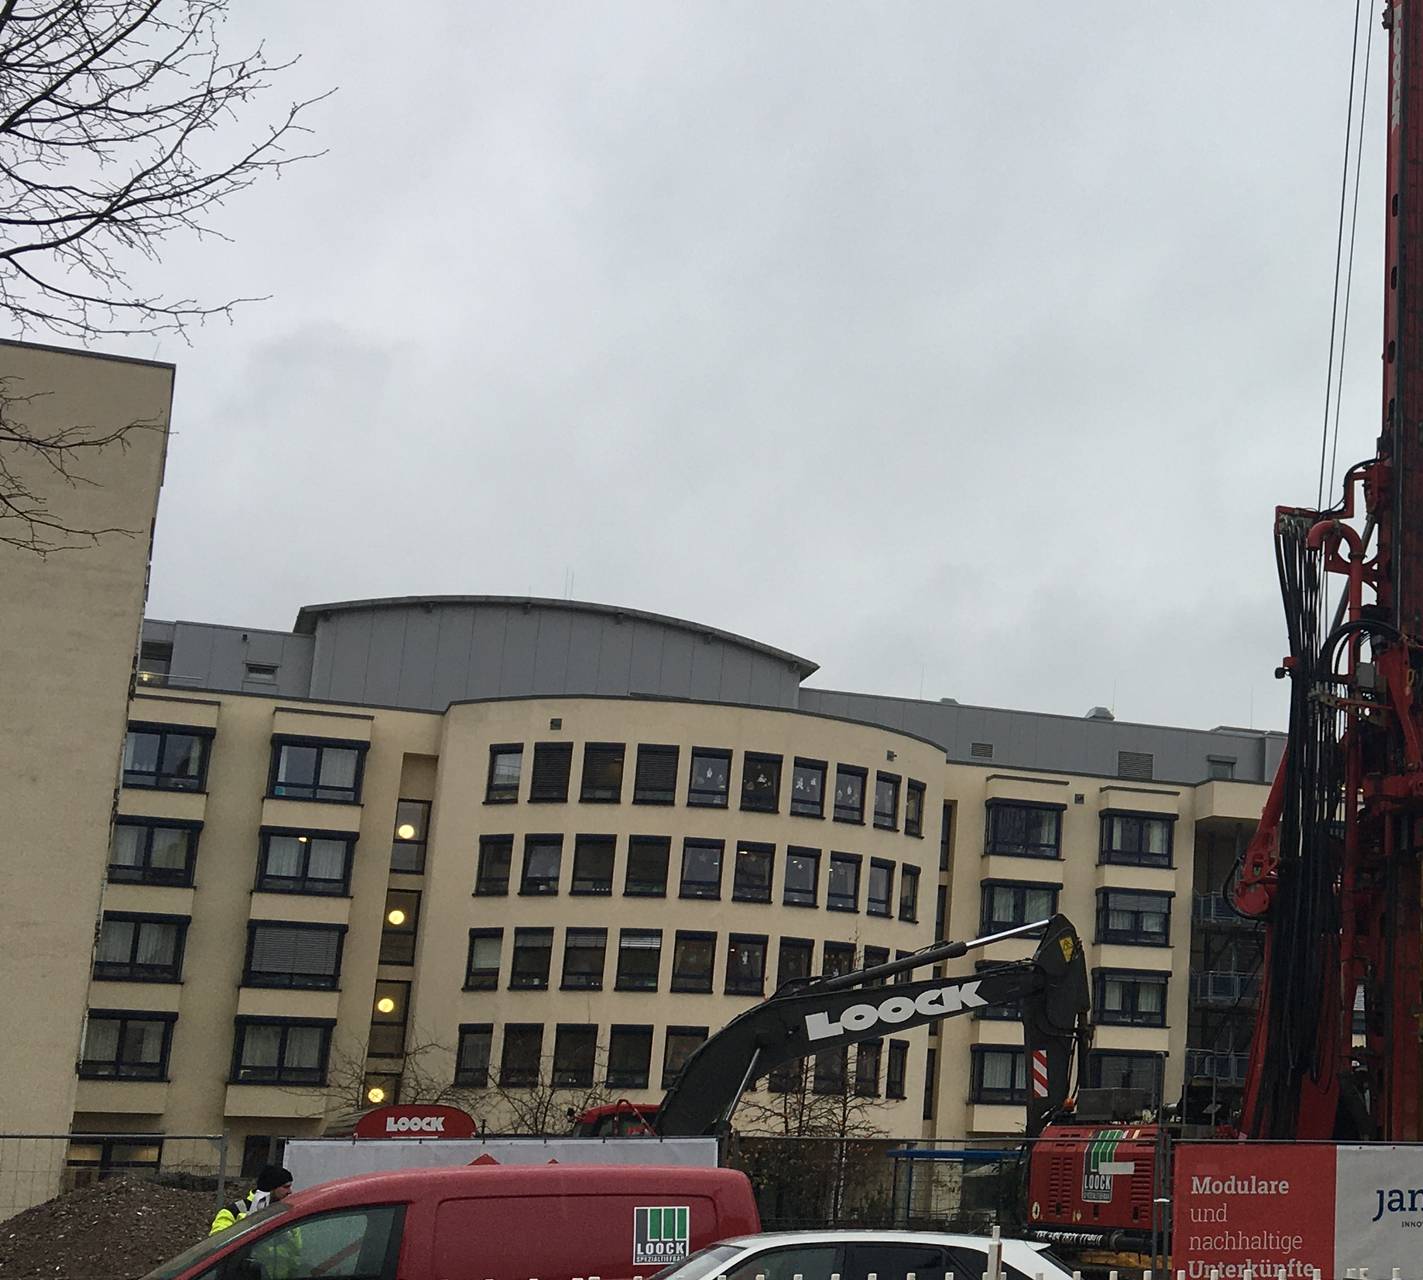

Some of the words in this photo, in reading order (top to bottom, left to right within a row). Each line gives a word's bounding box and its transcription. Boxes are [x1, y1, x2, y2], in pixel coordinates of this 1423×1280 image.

[805, 980, 989, 1041] LOOCK
[386, 1116, 445, 1132] LOOCK
[1084, 1174, 1111, 1190] LOOCK
[1190, 1175, 1290, 1195] Modulare
[1190, 1202, 1228, 1223] und
[636, 1242, 685, 1255] LOOCK
[1189, 1230, 1303, 1255] nachhaltige
[1188, 1258, 1314, 1279] Unterkünfte
